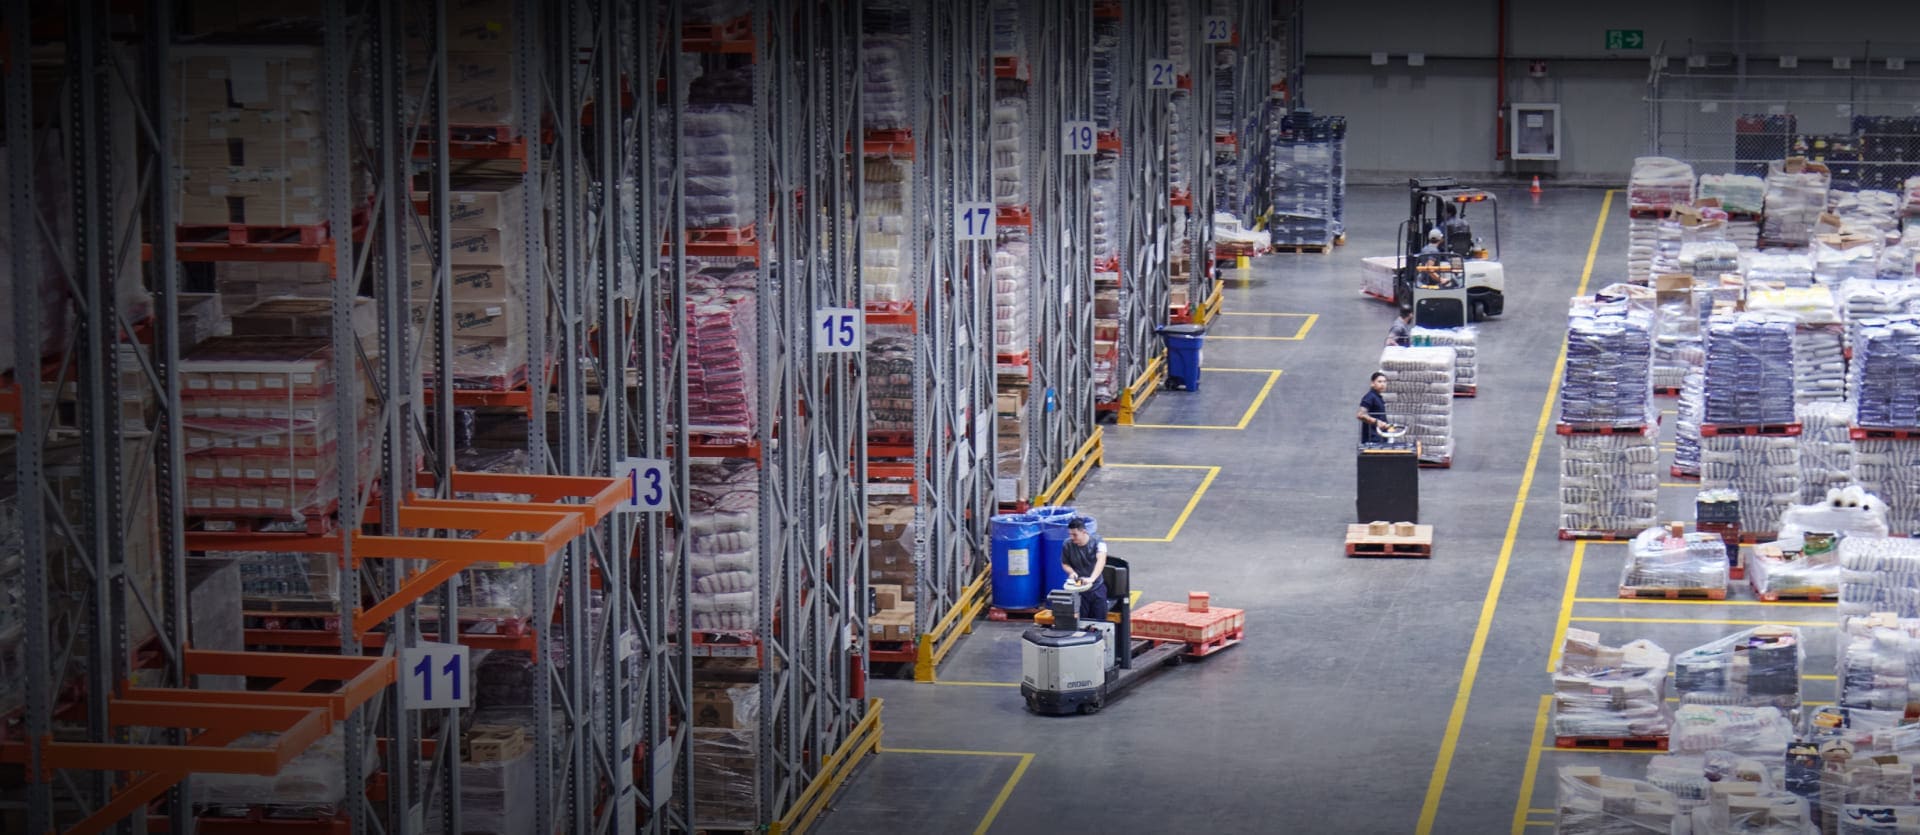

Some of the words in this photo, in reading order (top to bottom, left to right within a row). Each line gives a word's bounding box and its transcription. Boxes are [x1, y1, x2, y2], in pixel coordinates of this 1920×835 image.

[1208, 20, 1227, 39] 23
[1153, 64, 1173, 86] 21
[1069, 127, 1092, 150] 19
[963, 209, 990, 235] 17
[823, 316, 854, 347] 15
[630, 467, 663, 505] 13
[414, 654, 462, 700] 11
